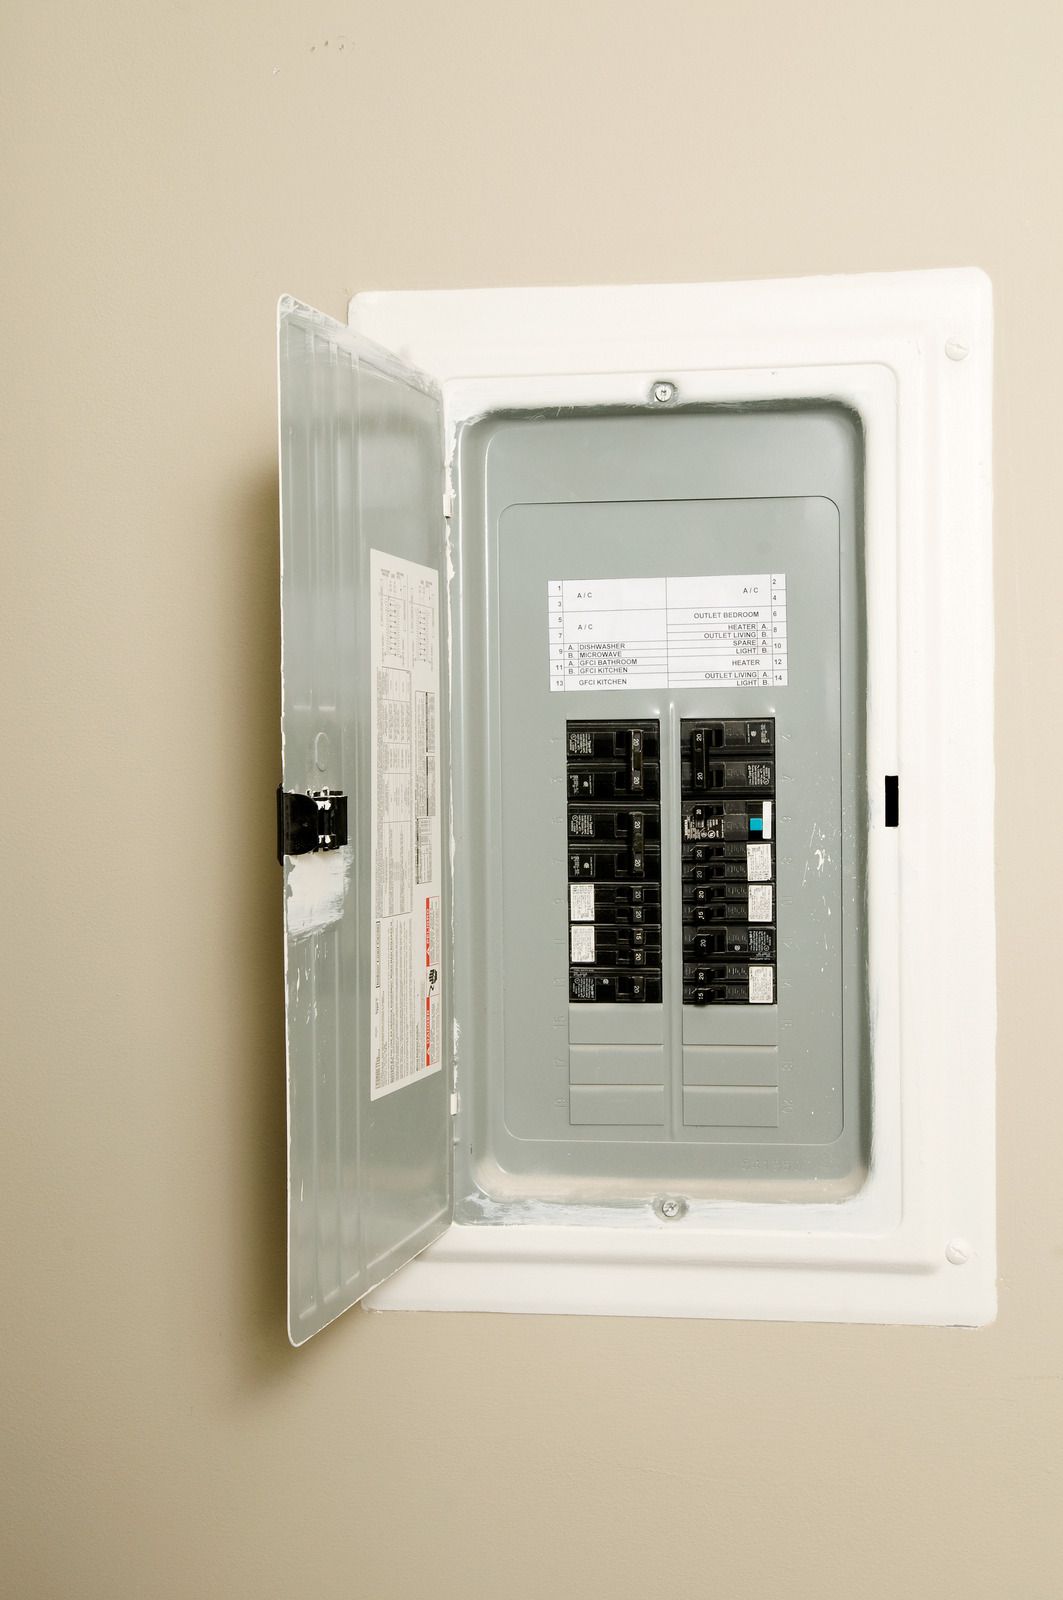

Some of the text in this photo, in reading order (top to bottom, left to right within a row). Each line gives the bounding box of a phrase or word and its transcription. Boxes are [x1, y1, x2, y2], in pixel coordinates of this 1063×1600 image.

[696, 733, 702, 742] 20
[633, 738, 640, 746] 20
[633, 776, 640, 784] 20
[697, 772, 703, 780] 20
[634, 985, 640, 993] 20
